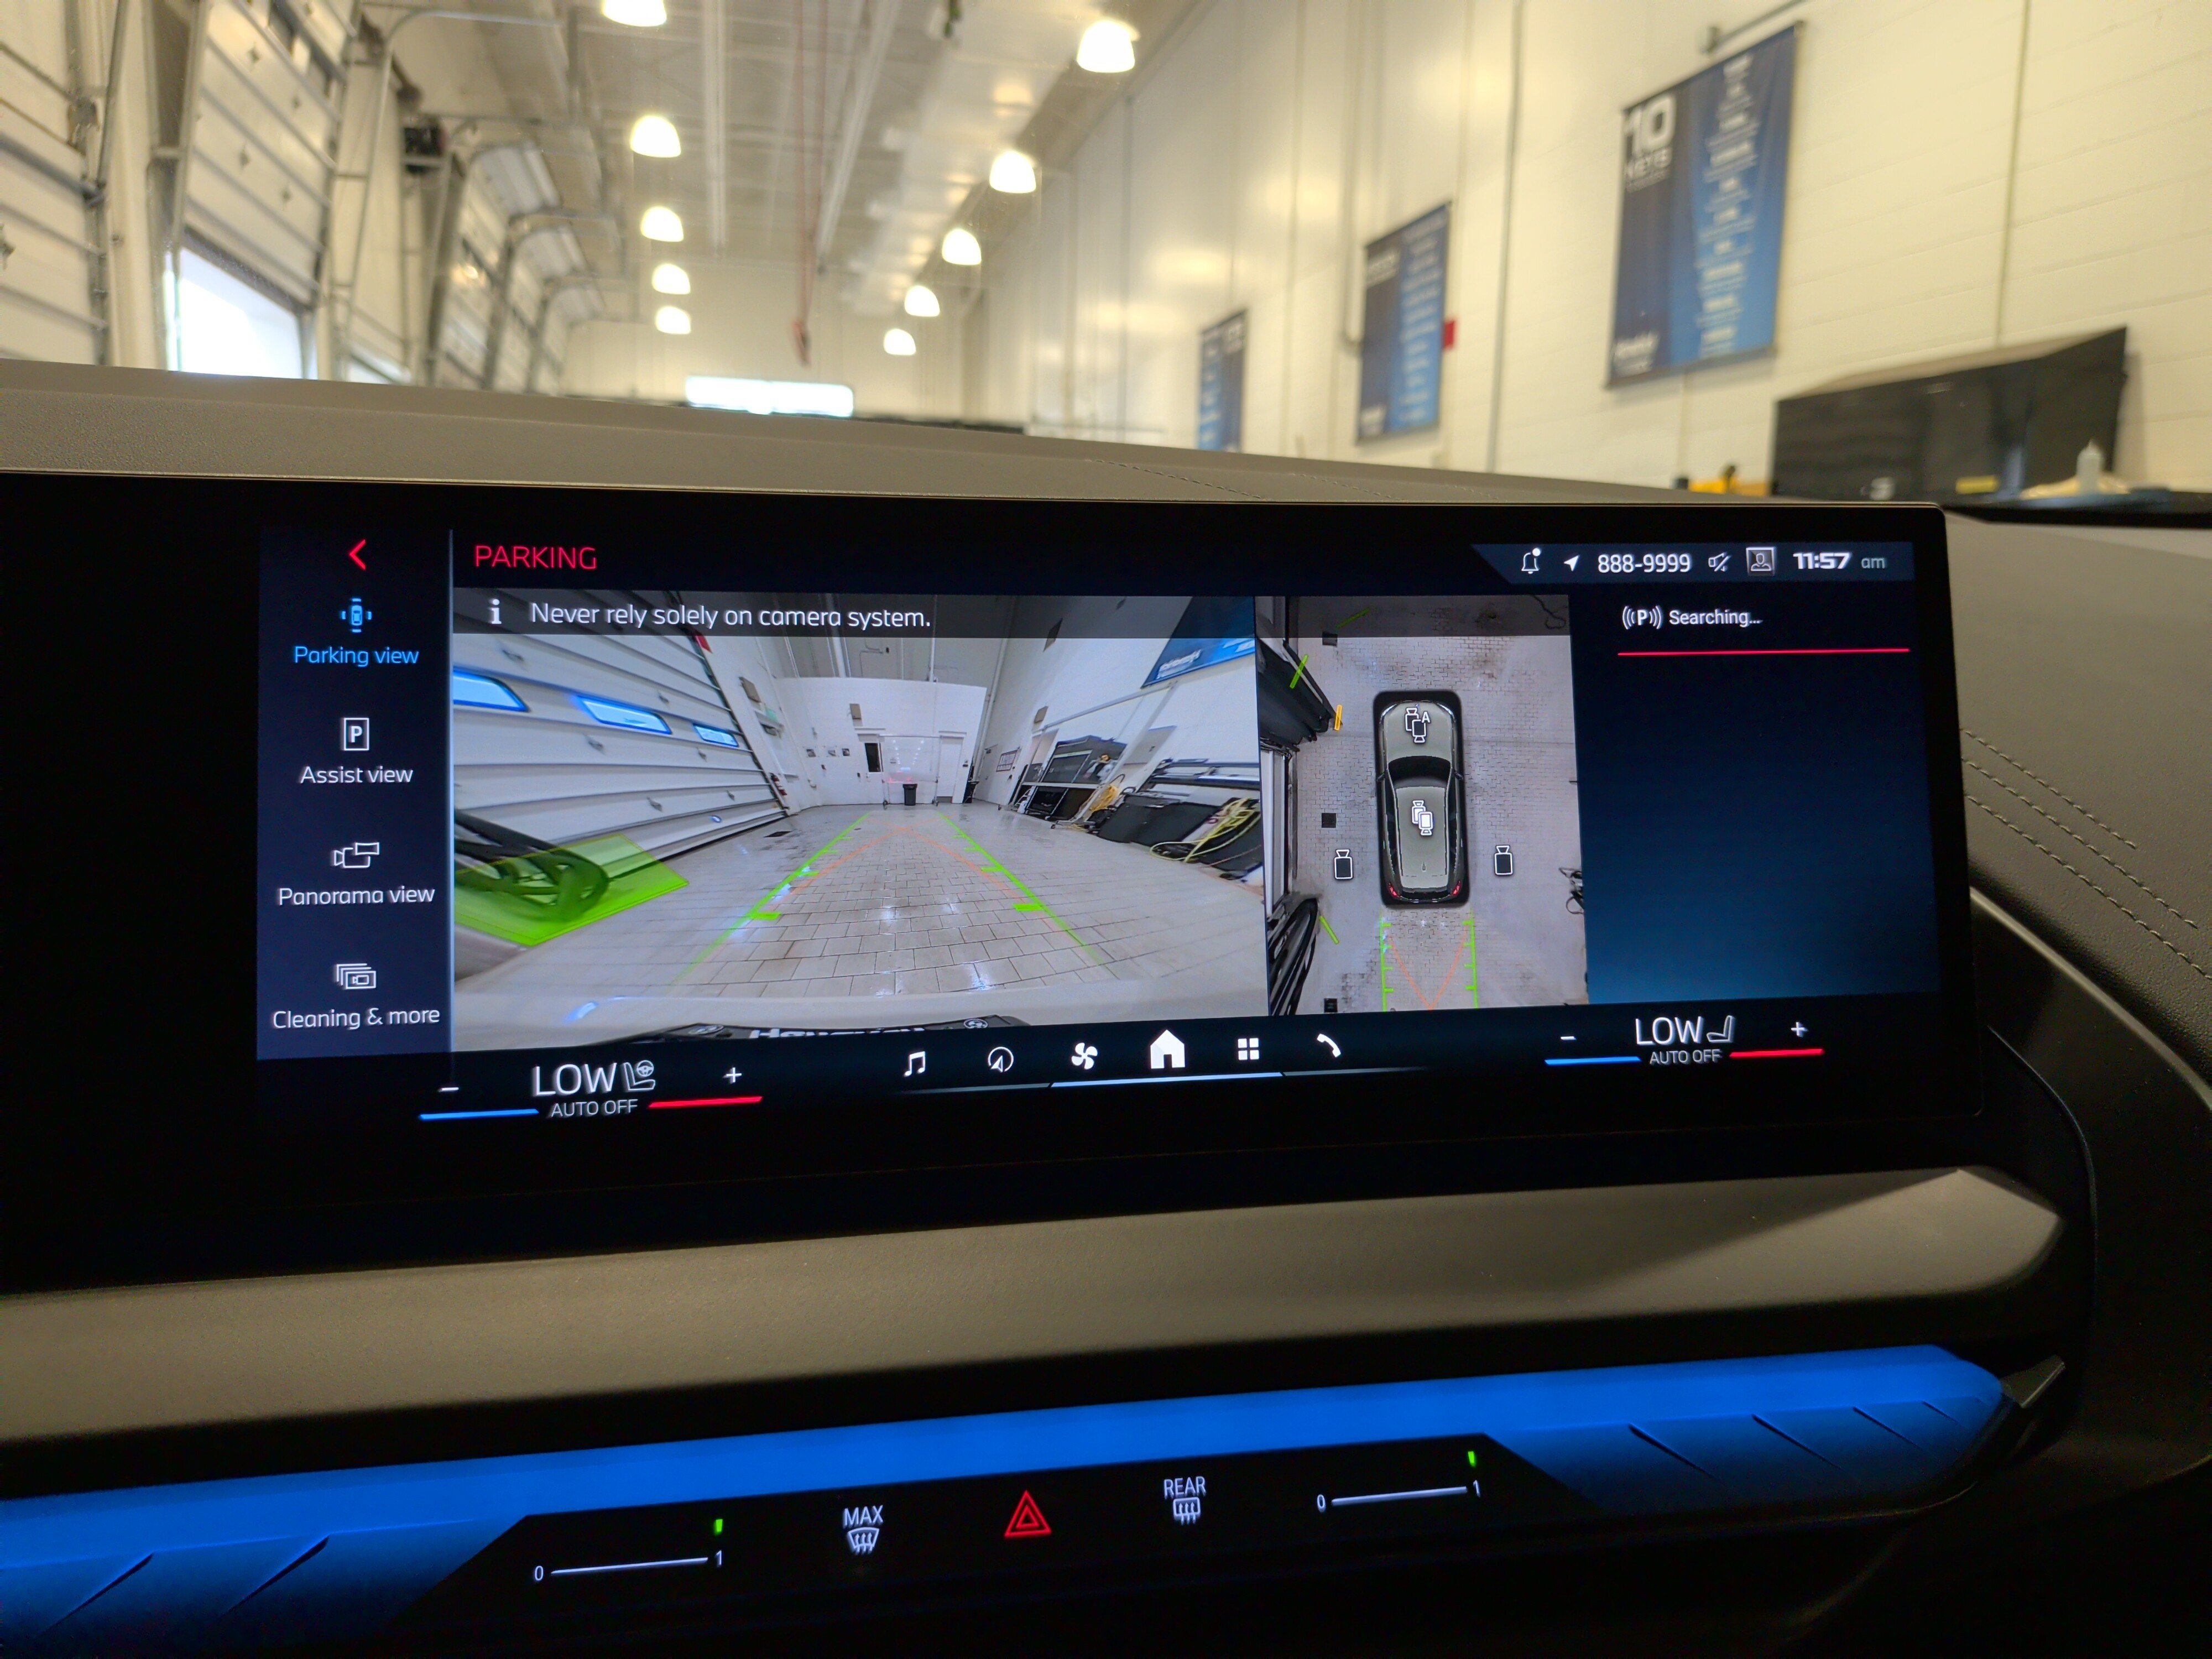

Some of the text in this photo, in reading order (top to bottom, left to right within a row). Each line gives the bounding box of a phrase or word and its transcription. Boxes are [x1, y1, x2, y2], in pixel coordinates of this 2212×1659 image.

[1624, 96, 1676, 157] 10
[475, 545, 597, 570] PARKING
[1598, 553, 1691, 573] 888-9999
[1793, 552, 1886, 570] 11:57 am
[530, 602, 599, 625] Never
[604, 604, 648, 628] rely
[653, 604, 719, 629] solely
[724, 610, 753, 625] on
[759, 610, 842, 627] camera
[848, 609, 931, 631] system.
[1669, 608, 1763, 628] Searching...
[294, 645, 420, 667] Parking view
[299, 765, 414, 784] Assist view
[278, 885, 435, 906] Panorama view
[273, 1007, 440, 1030] Cleaning & more
[1635, 1016, 1704, 1046] LOW
[1649, 1048, 1722, 1065] AUTO OFF
[534, 1062, 617, 1097] LOW
[549, 1098, 638, 1118] AUTO OFF
[1164, 1476, 1206, 1499] REAR
[1472, 1479, 1481, 1497] 1
[1316, 1494, 1326, 1512] 0
[843, 1505, 884, 1526] MAX
[715, 1550, 723, 1567] 1
[534, 1565, 544, 1582] 0
